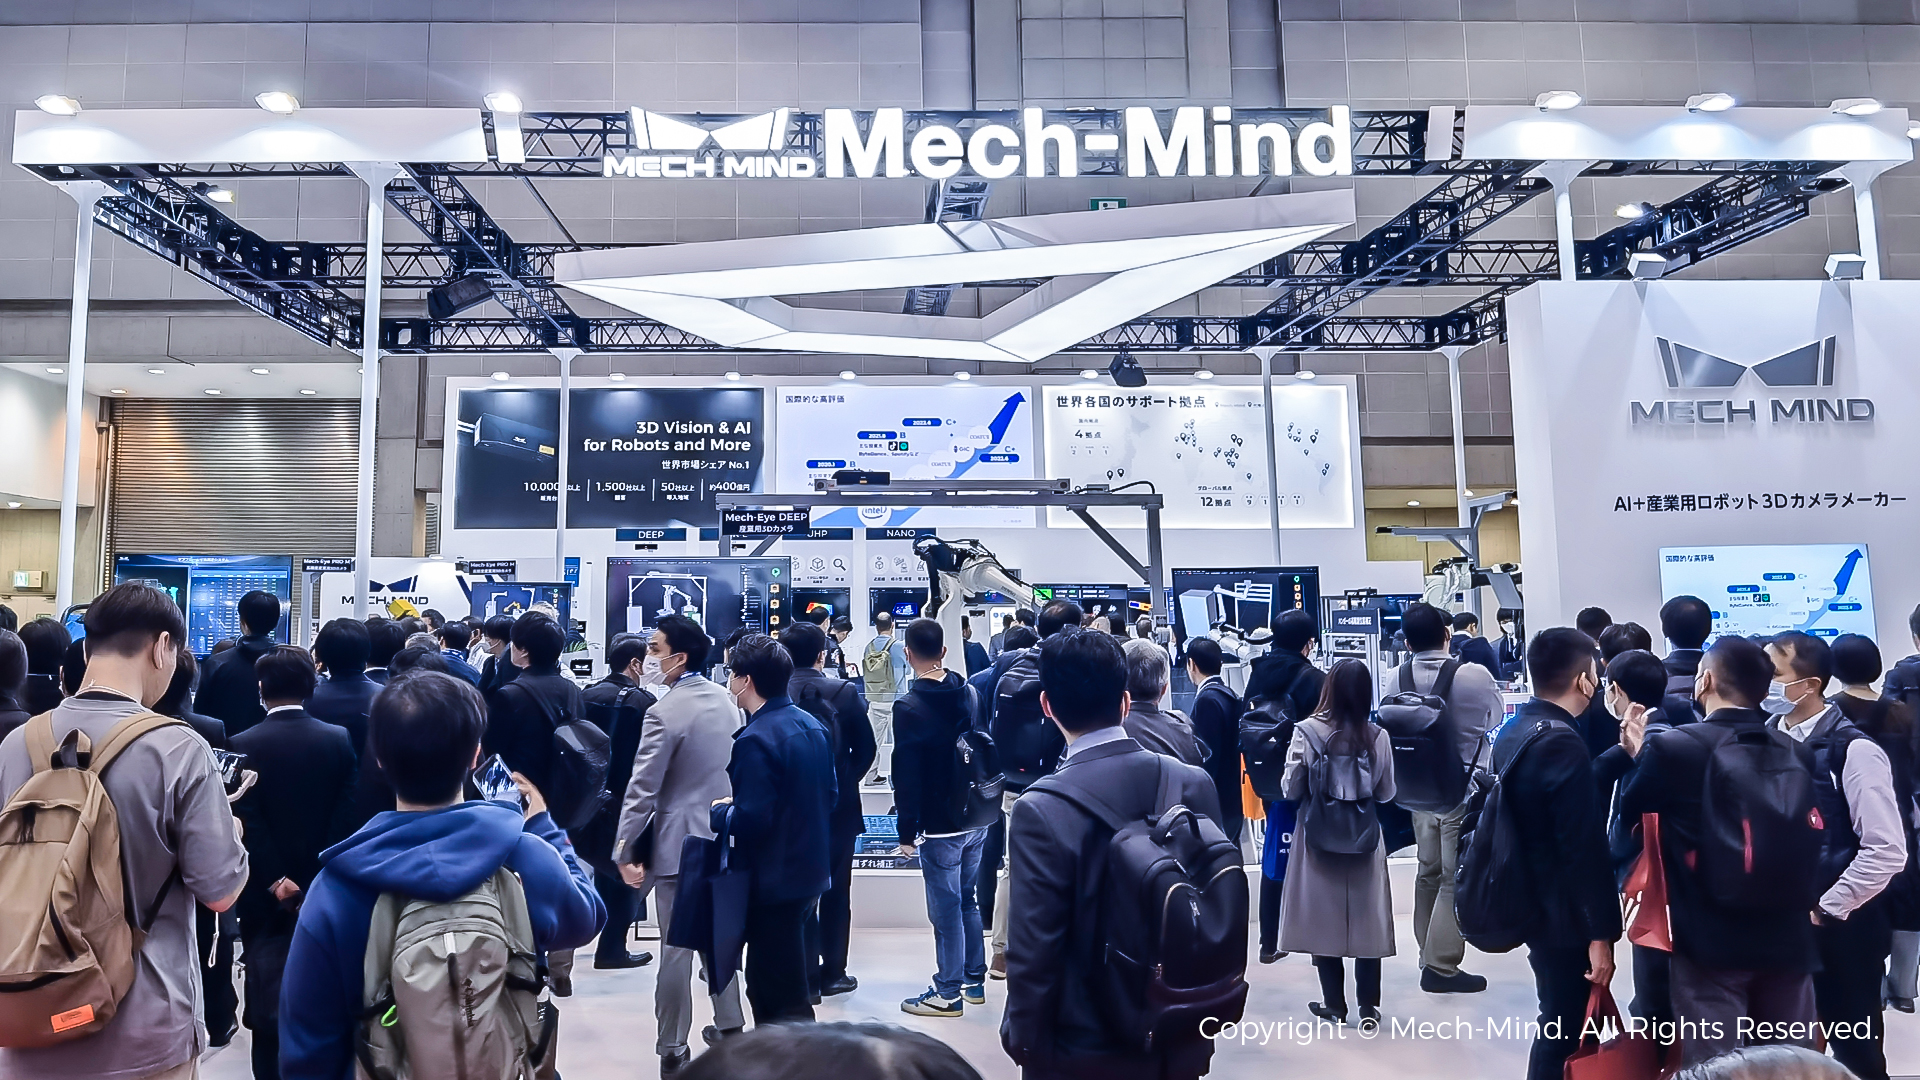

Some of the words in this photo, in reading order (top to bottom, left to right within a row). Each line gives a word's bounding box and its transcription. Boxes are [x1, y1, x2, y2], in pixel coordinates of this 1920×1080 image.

[824, 105, 1352, 178] Mech-Mind
[603, 157, 714, 178] MECH
[724, 157, 816, 178] MIND
[1056, 395, 1206, 409] 世界各国のサポート拠点
[1630, 399, 1756, 424] MECH
[1769, 399, 1875, 423] MIND
[636, 422, 660, 434] 3D
[664, 421, 714, 434] Vision
[718, 422, 730, 434] &
[734, 422, 751, 434] AI
[584, 439, 607, 451] for
[611, 439, 670, 451] Robots
[674, 439, 704, 451] and
[711, 440, 751, 451] More
[661, 460, 726, 470] 世界市場シェア
[728, 461, 749, 469] No.1
[1614, 492, 1907, 512] AI+産業用ロボット3Dカメラメーカー
[725, 513, 775, 522] Mech-Eye
[778, 513, 808, 521] DEEP
[638, 530, 665, 539] DEEP
[886, 529, 916, 538] NANO
